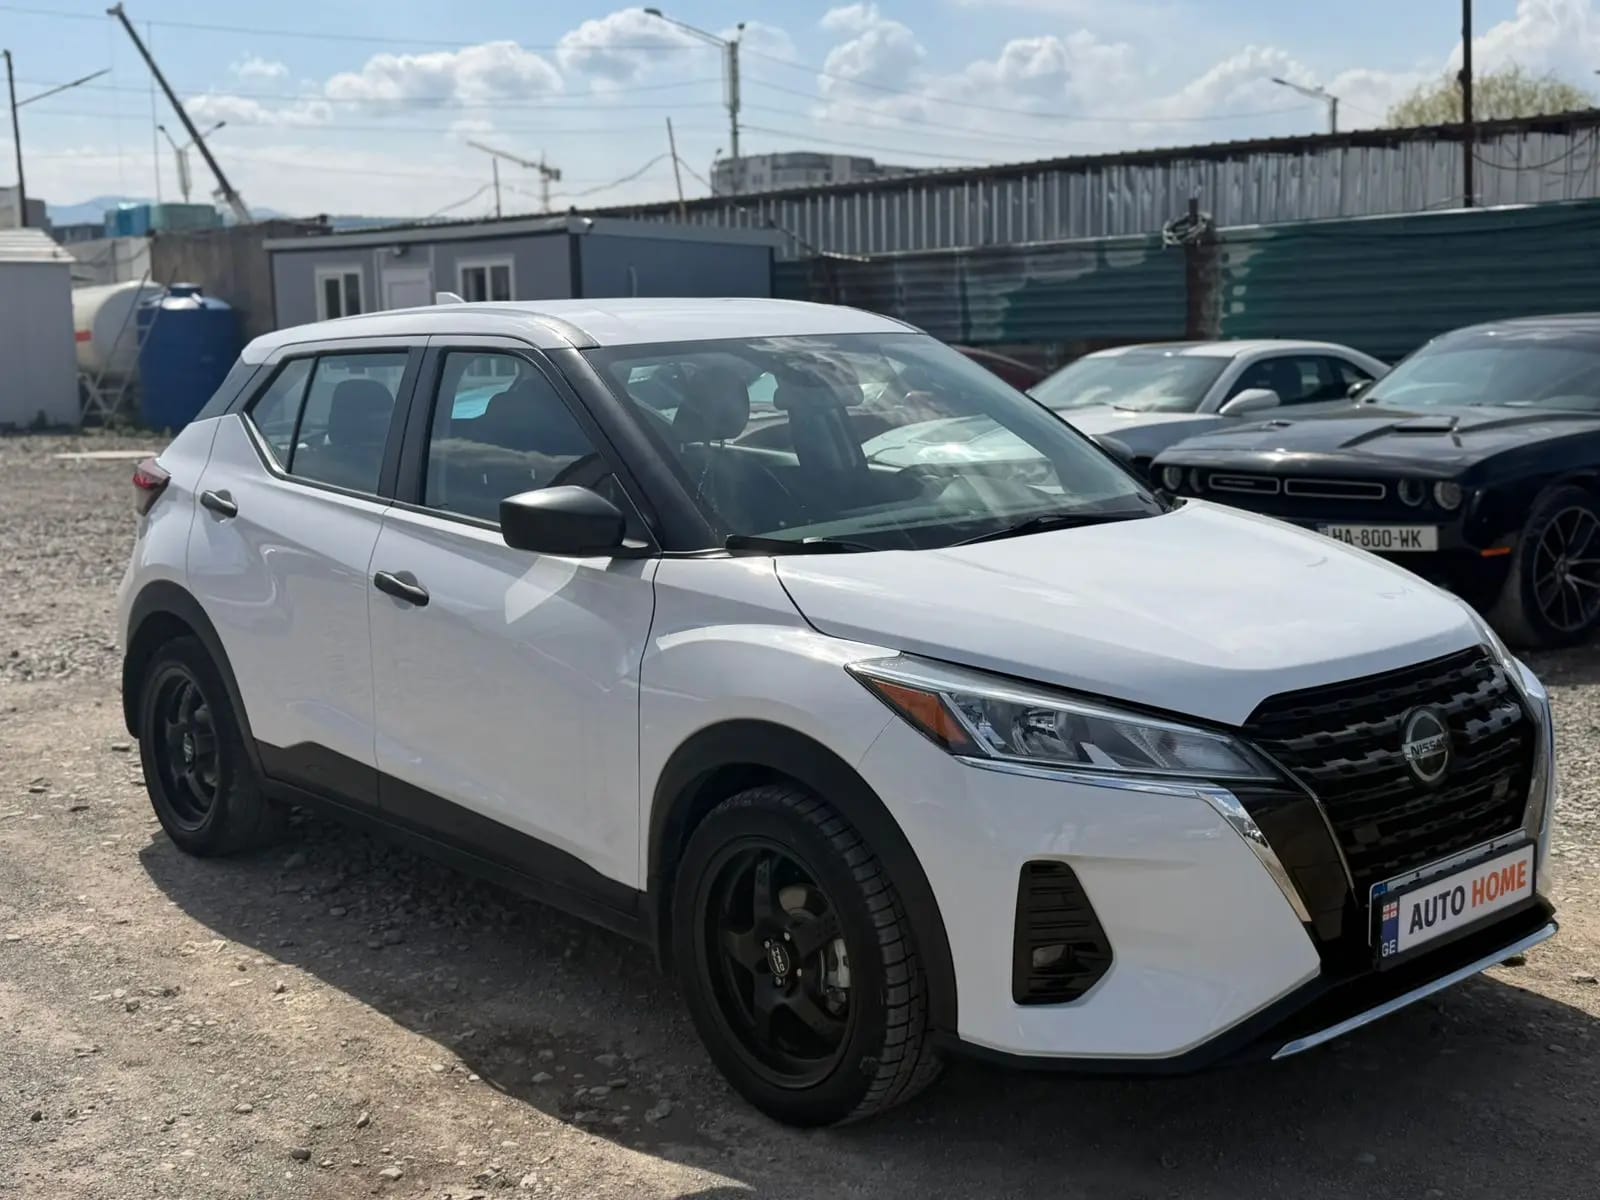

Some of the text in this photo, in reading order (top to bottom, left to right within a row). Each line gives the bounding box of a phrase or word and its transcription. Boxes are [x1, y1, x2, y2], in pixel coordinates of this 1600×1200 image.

[1408, 859, 1528, 935] AUTO HOME
[1381, 938, 1397, 958] GE
